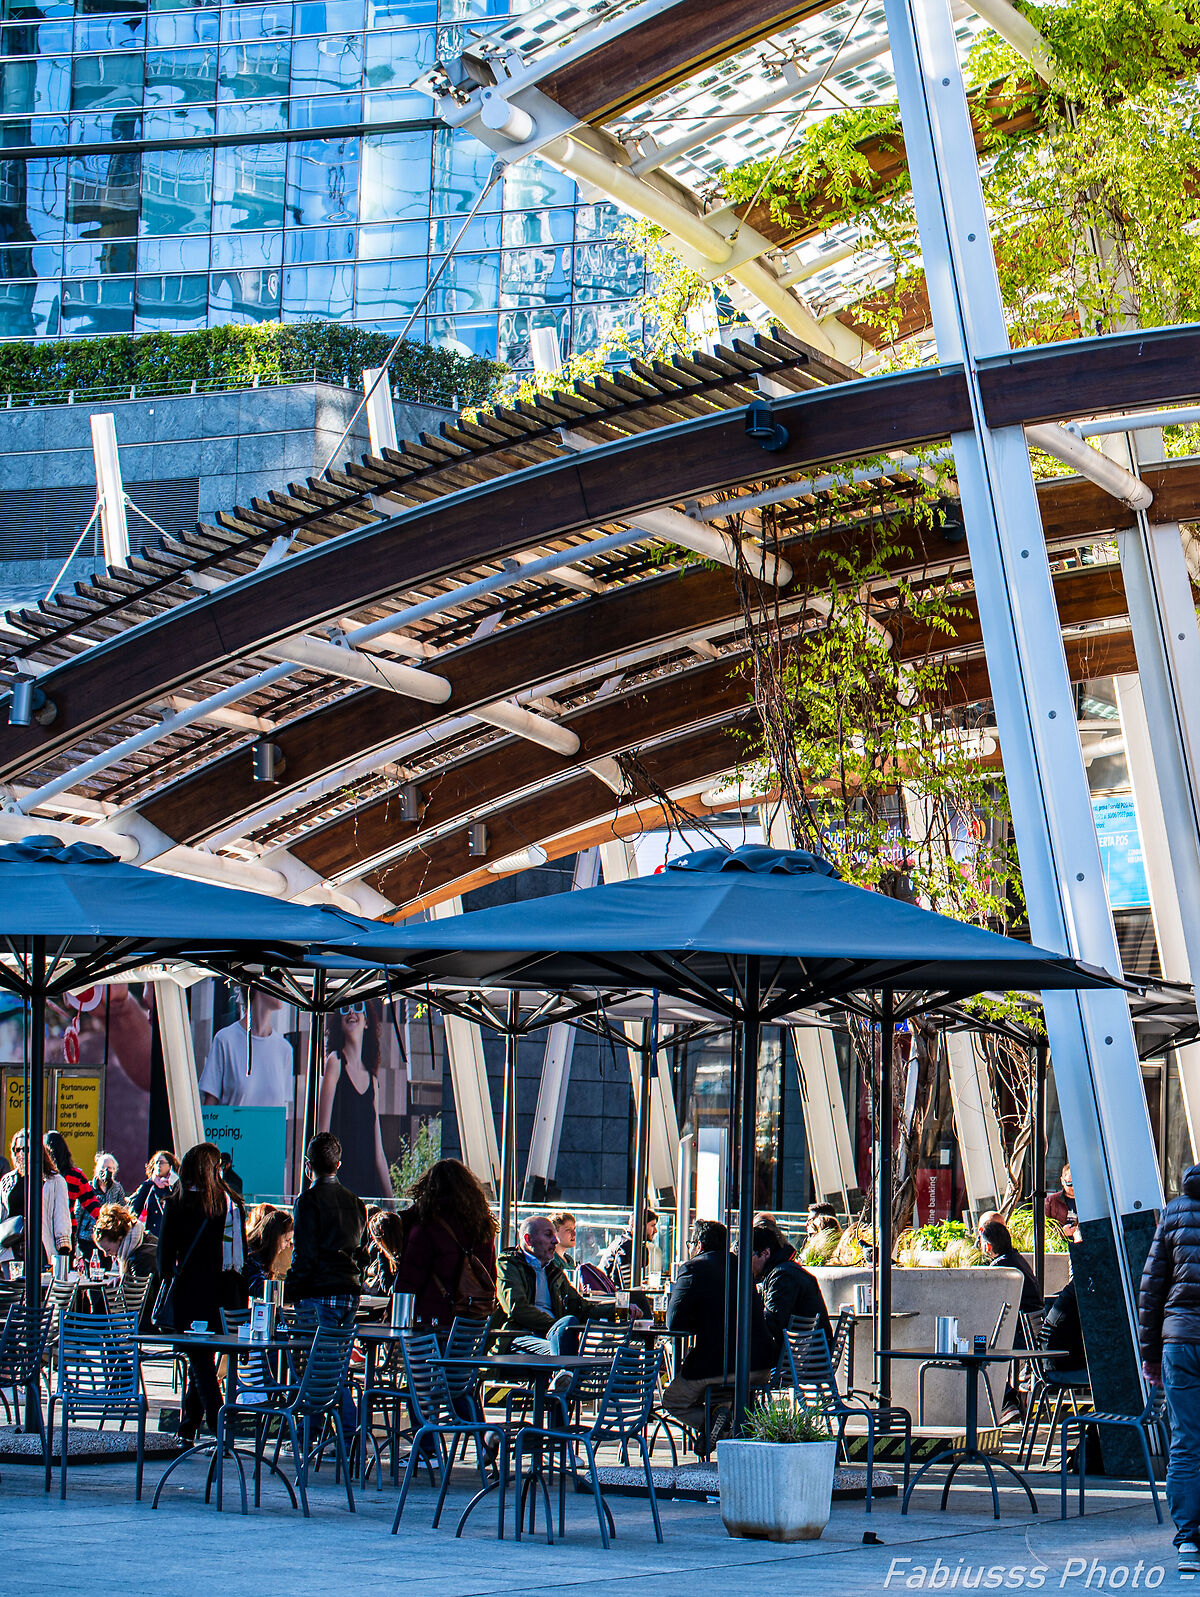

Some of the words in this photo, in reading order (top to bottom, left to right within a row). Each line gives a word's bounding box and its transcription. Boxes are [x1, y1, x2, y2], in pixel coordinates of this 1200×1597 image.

[1098, 835, 1115, 848] ERTA
[1116, 834, 1128, 846] POS
[61, 1102, 88, 1110] quartiere
[210, 1112, 219, 1120] for
[60, 1121, 90, 1129] sorprende
[60, 1131, 73, 1139] ogni
[74, 1131, 95, 1139] giorno.
[205, 1125, 243, 1140] opping,
[928, 1176, 937, 1208] banking
